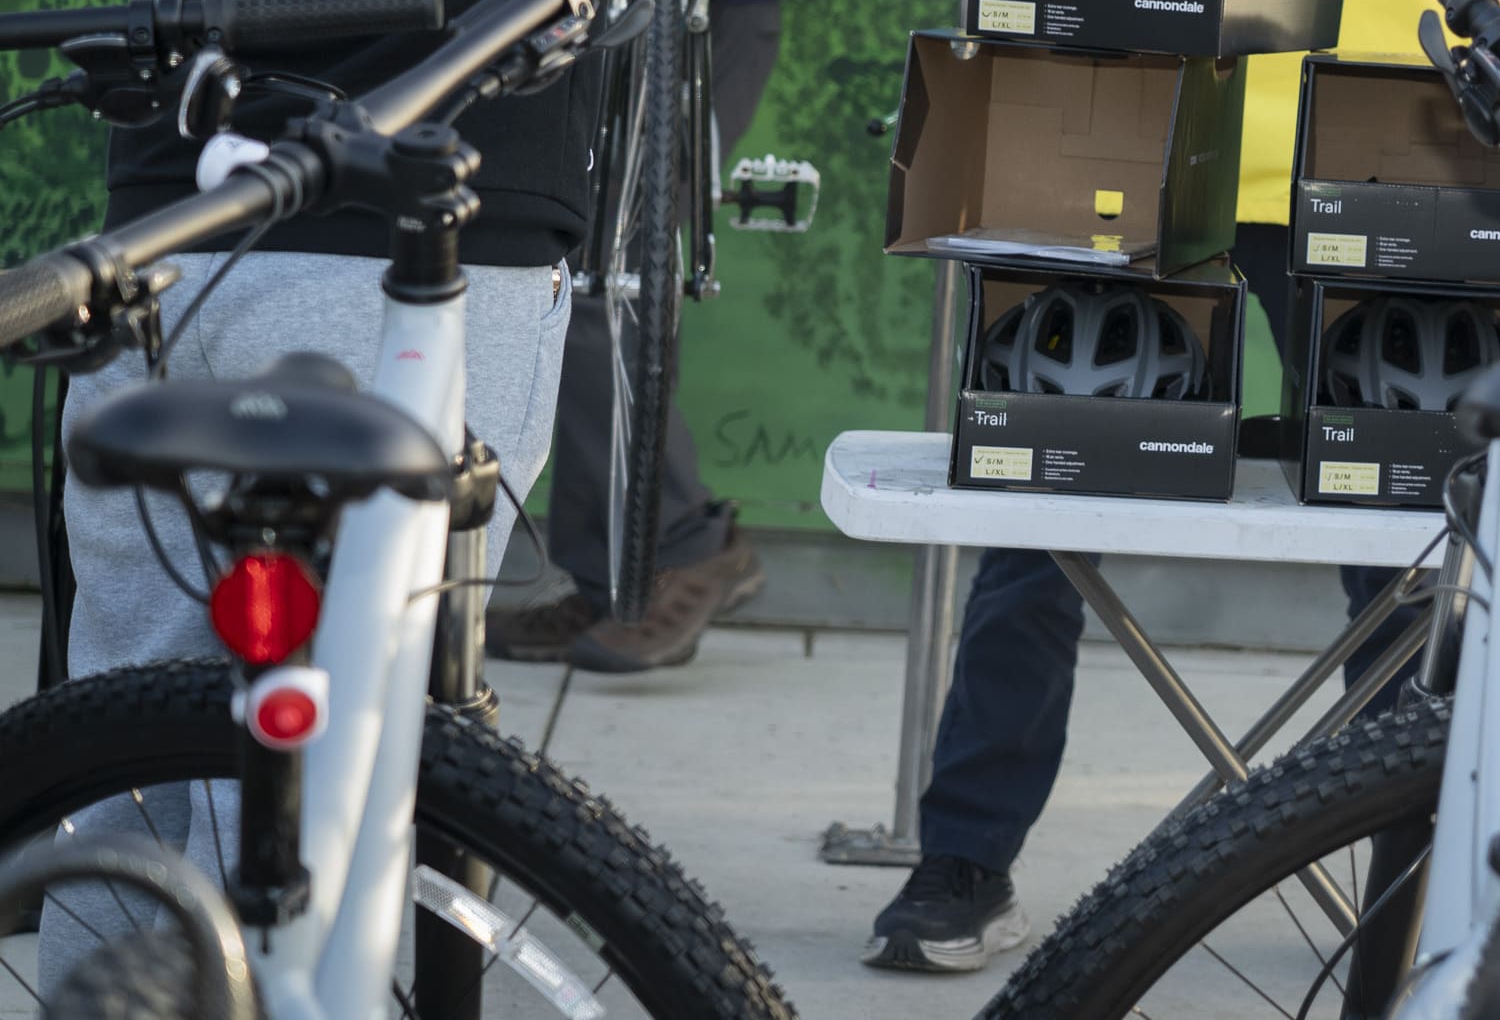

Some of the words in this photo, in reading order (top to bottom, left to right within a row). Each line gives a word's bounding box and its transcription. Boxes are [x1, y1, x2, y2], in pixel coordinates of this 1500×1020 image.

[1310, 198, 1342, 214] Trail
[974, 410, 1007, 426] Trail
[713, 408, 820, 468] SAM
[1322, 426, 1354, 442] Trail
[1139, 441, 1214, 454] cannondale
